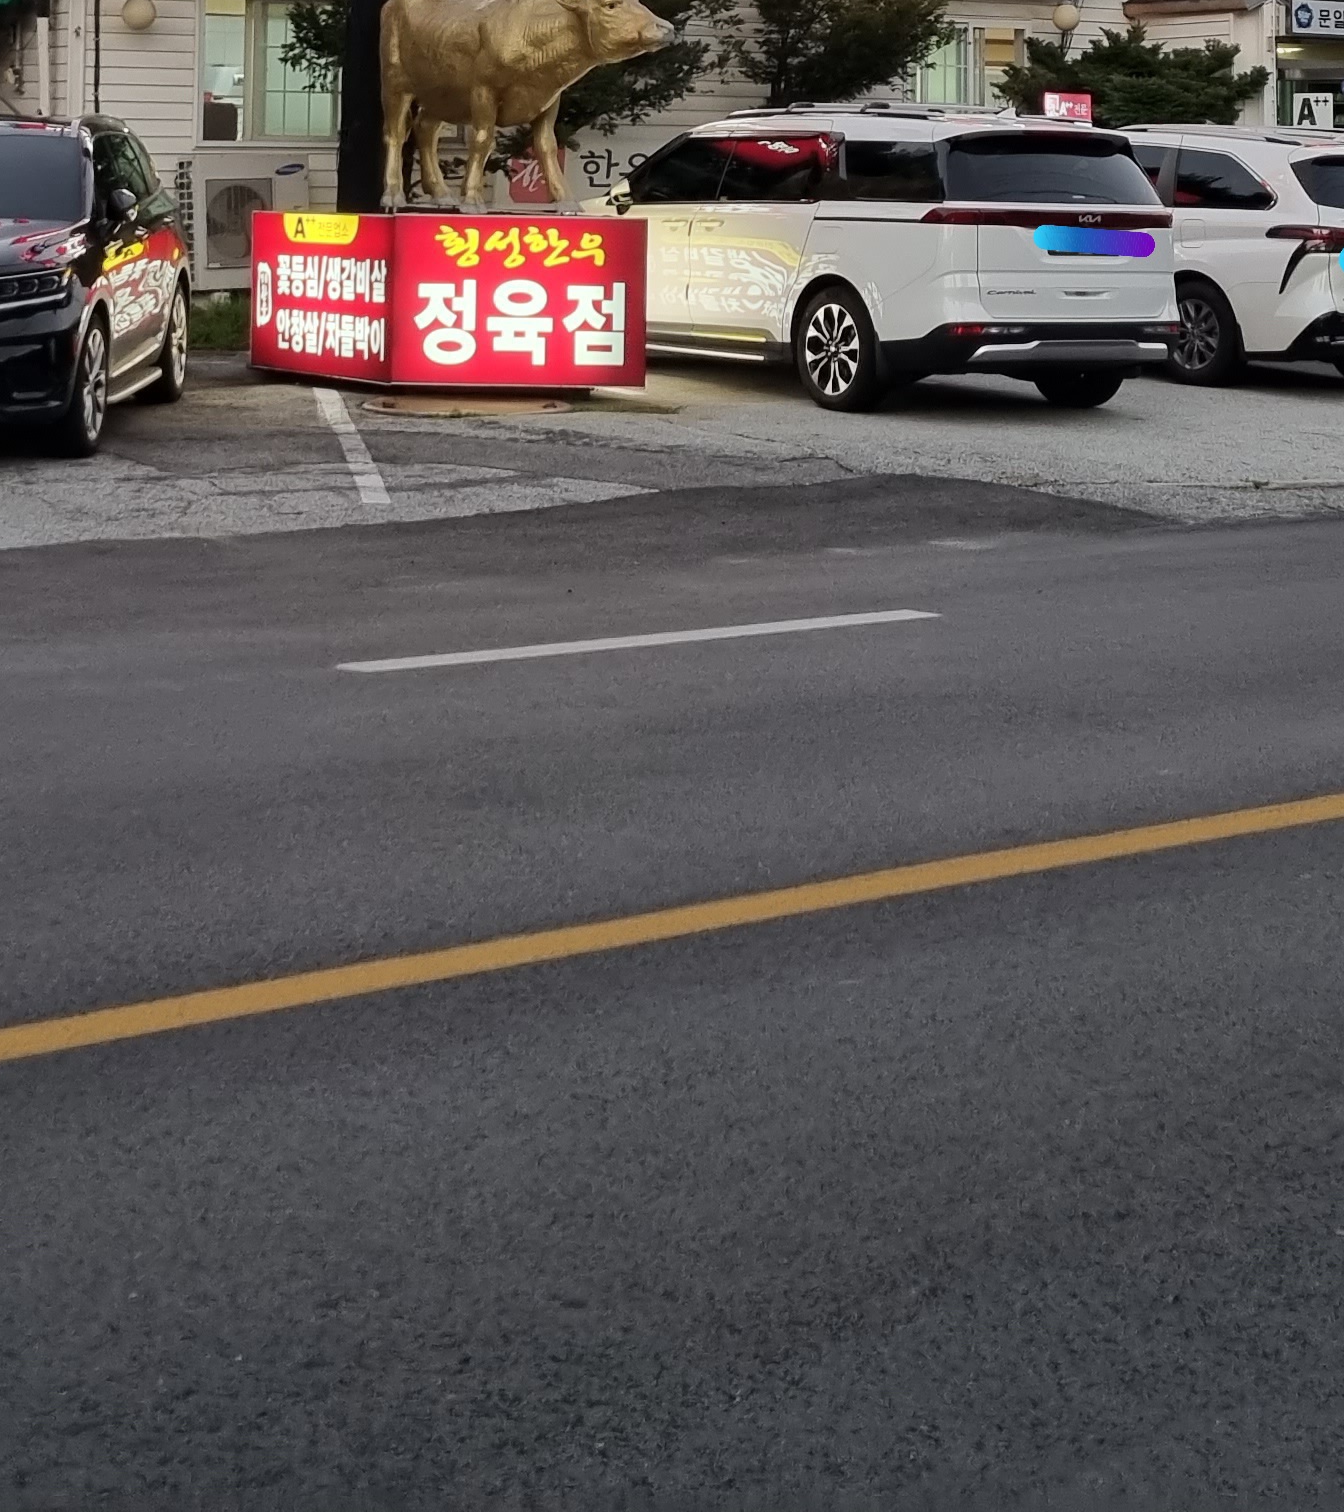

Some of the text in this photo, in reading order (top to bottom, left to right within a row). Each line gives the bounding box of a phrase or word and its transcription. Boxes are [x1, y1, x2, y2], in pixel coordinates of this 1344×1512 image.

[435, 224, 608, 268] 횡성한우
[276, 254, 387, 303] 꽃등심/생갈비살
[276, 309, 385, 362] 안창살/차돌박이
[413, 279, 627, 366] 정육점
